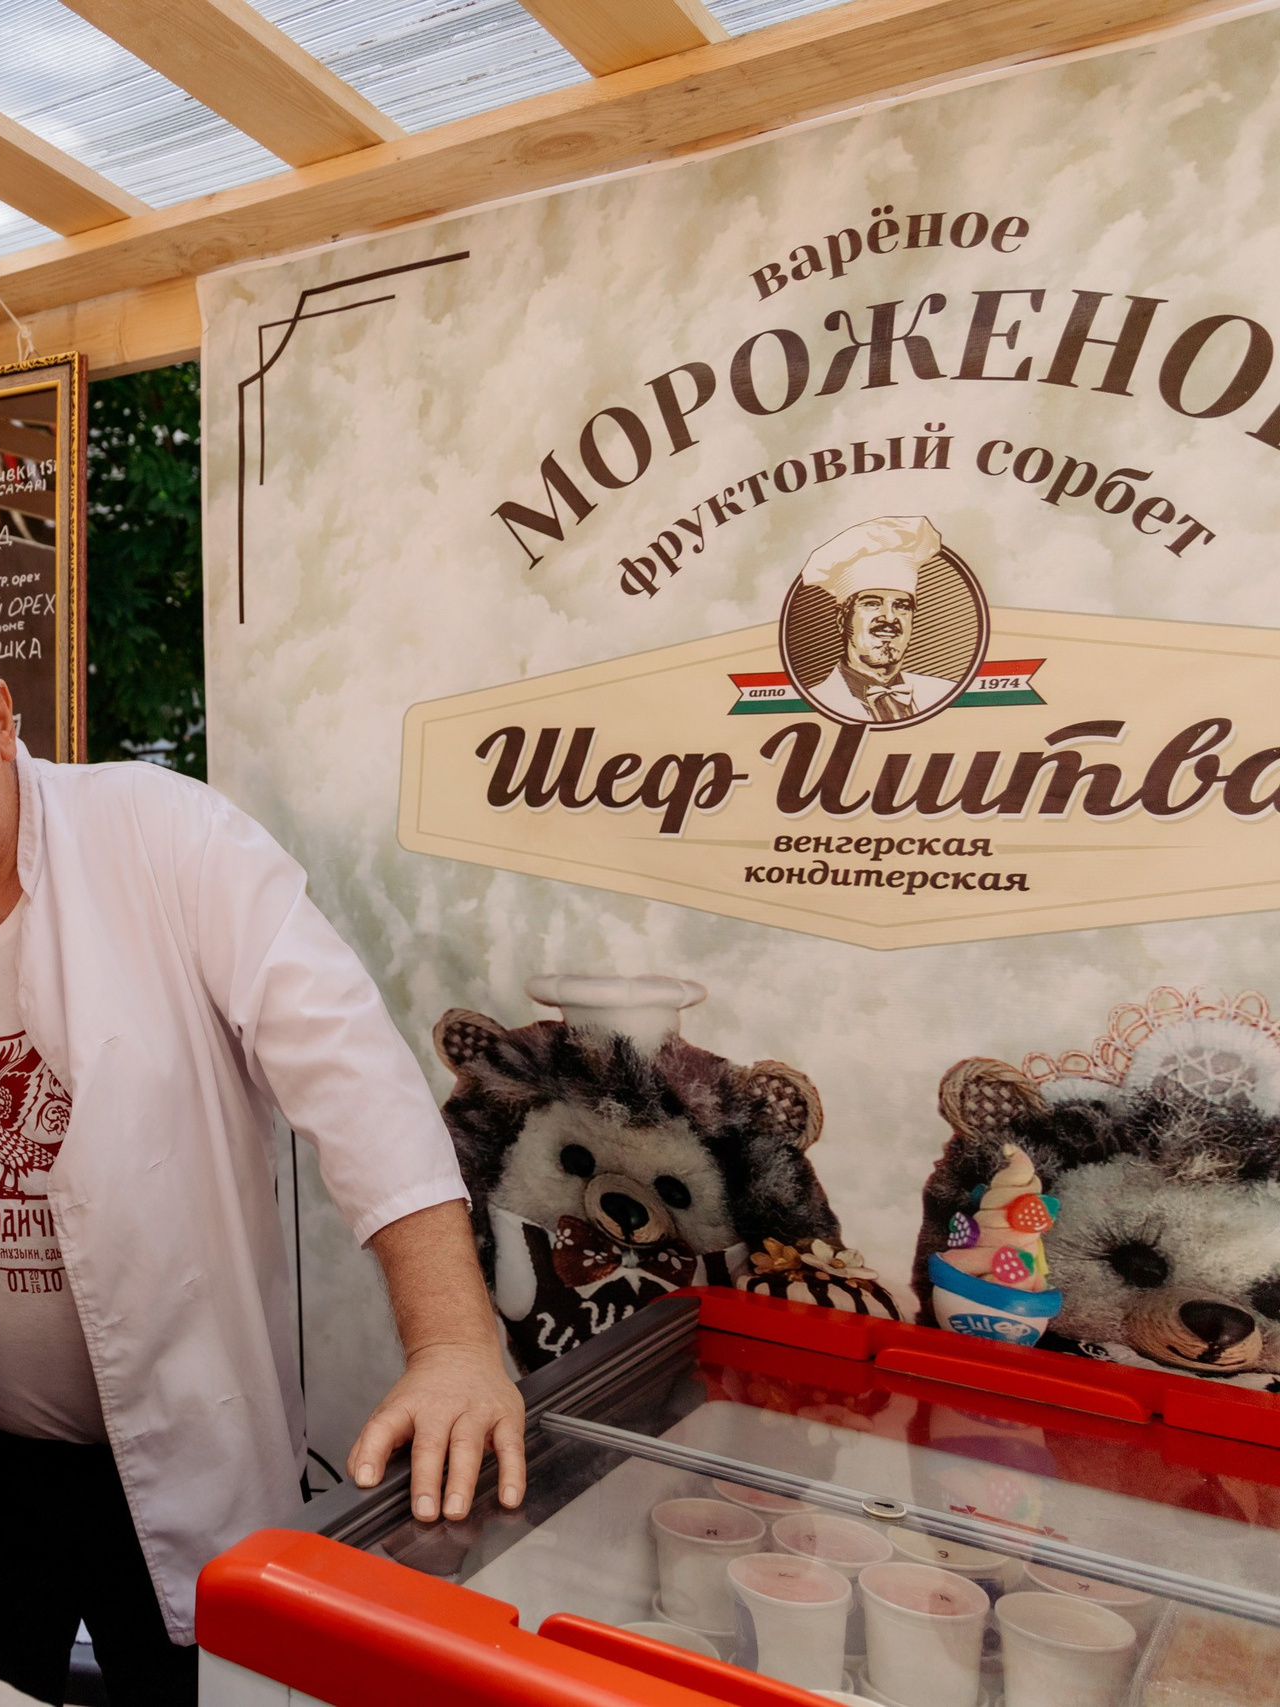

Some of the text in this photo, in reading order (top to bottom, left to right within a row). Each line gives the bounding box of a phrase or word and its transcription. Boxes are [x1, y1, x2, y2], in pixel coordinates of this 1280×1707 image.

[749, 205, 1031, 301] варёное
[490, 288, 1280, 570] МОРОЖЕНО
[619, 421, 1217, 600] фруктовый сорбет
[7, 592, 57, 617] ОРЕХ
[748, 677, 1022, 699] anno 1974
[474, 724, 748, 836] Шеф
[772, 830, 994, 862] венгерская
[744, 862, 1031, 896] кондитерская
[7, 1269, 29, 1293] 01
[40, 1269, 63, 1294] 10
